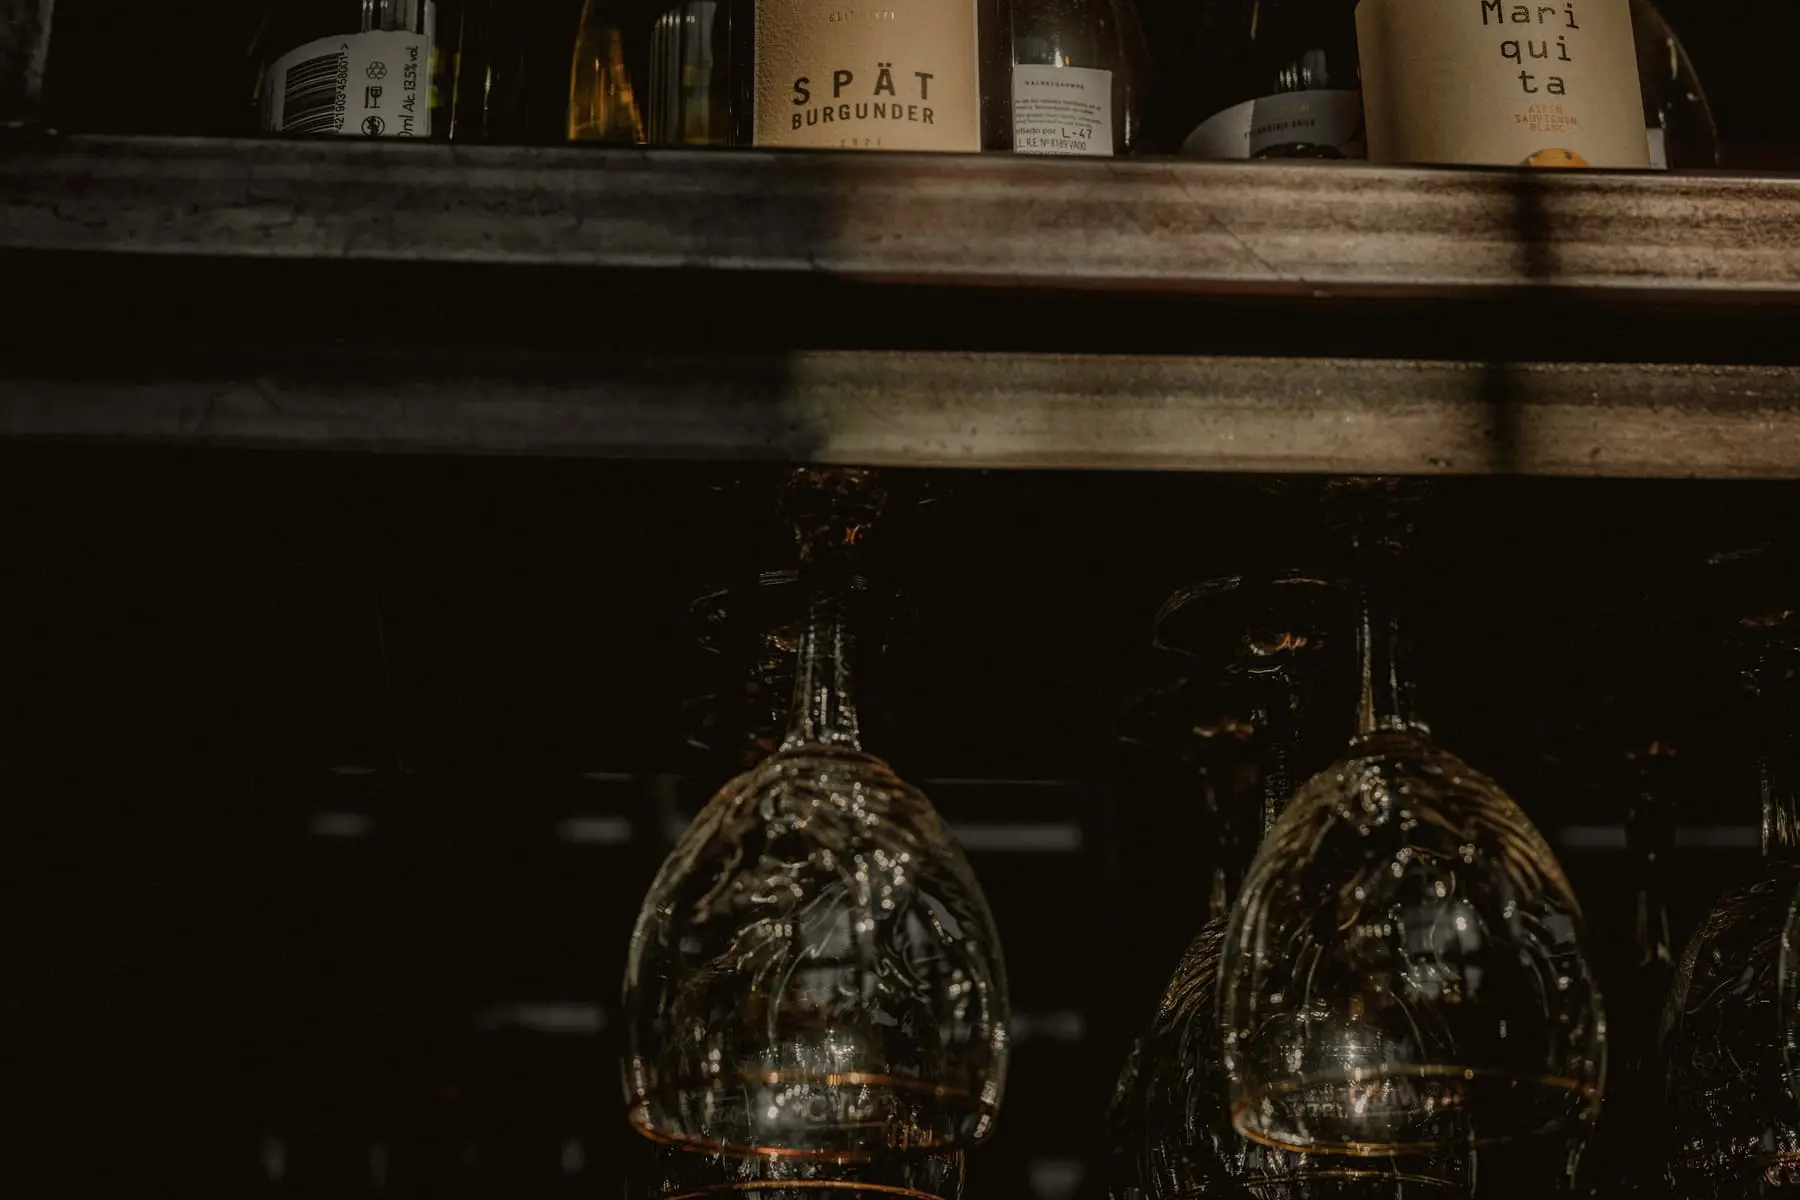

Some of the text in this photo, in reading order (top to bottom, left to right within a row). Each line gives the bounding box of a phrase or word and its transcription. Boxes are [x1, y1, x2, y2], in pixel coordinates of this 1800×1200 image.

[1480, 0, 1580, 29] Mari
[1499, 35, 1573, 64] qui
[792, 62, 934, 105] SPÄT
[1518, 70, 1567, 96] ta
[791, 102, 934, 130] BURGUNDER
